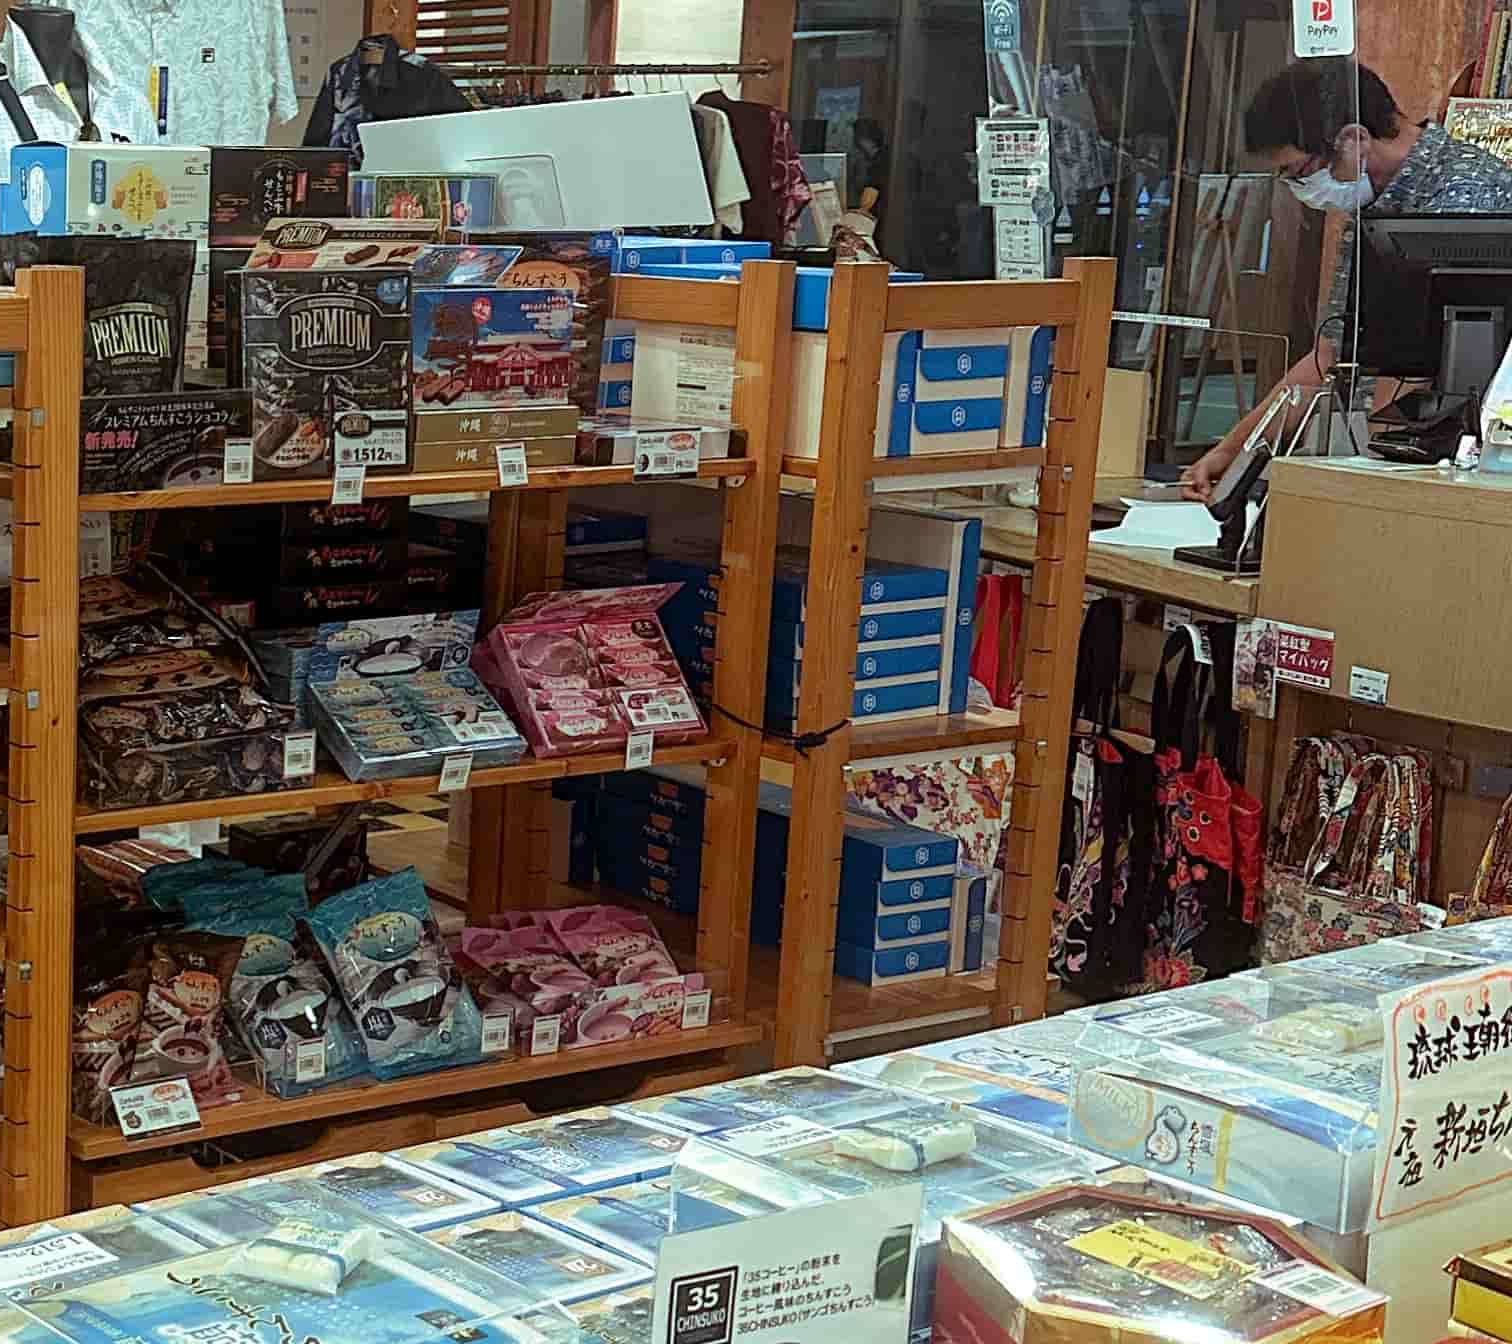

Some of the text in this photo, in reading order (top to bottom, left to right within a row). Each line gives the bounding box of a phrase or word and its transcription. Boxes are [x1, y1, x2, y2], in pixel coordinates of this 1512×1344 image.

[1307, 24, 1338, 38] PayPay
[275, 225, 328, 245] PREMIUM
[90, 311, 171, 361] PREMIUM
[290, 307, 372, 353] PREMIUM
[687, 1283, 721, 1312] 35
[676, 1306, 726, 1334] CHINSUKO
